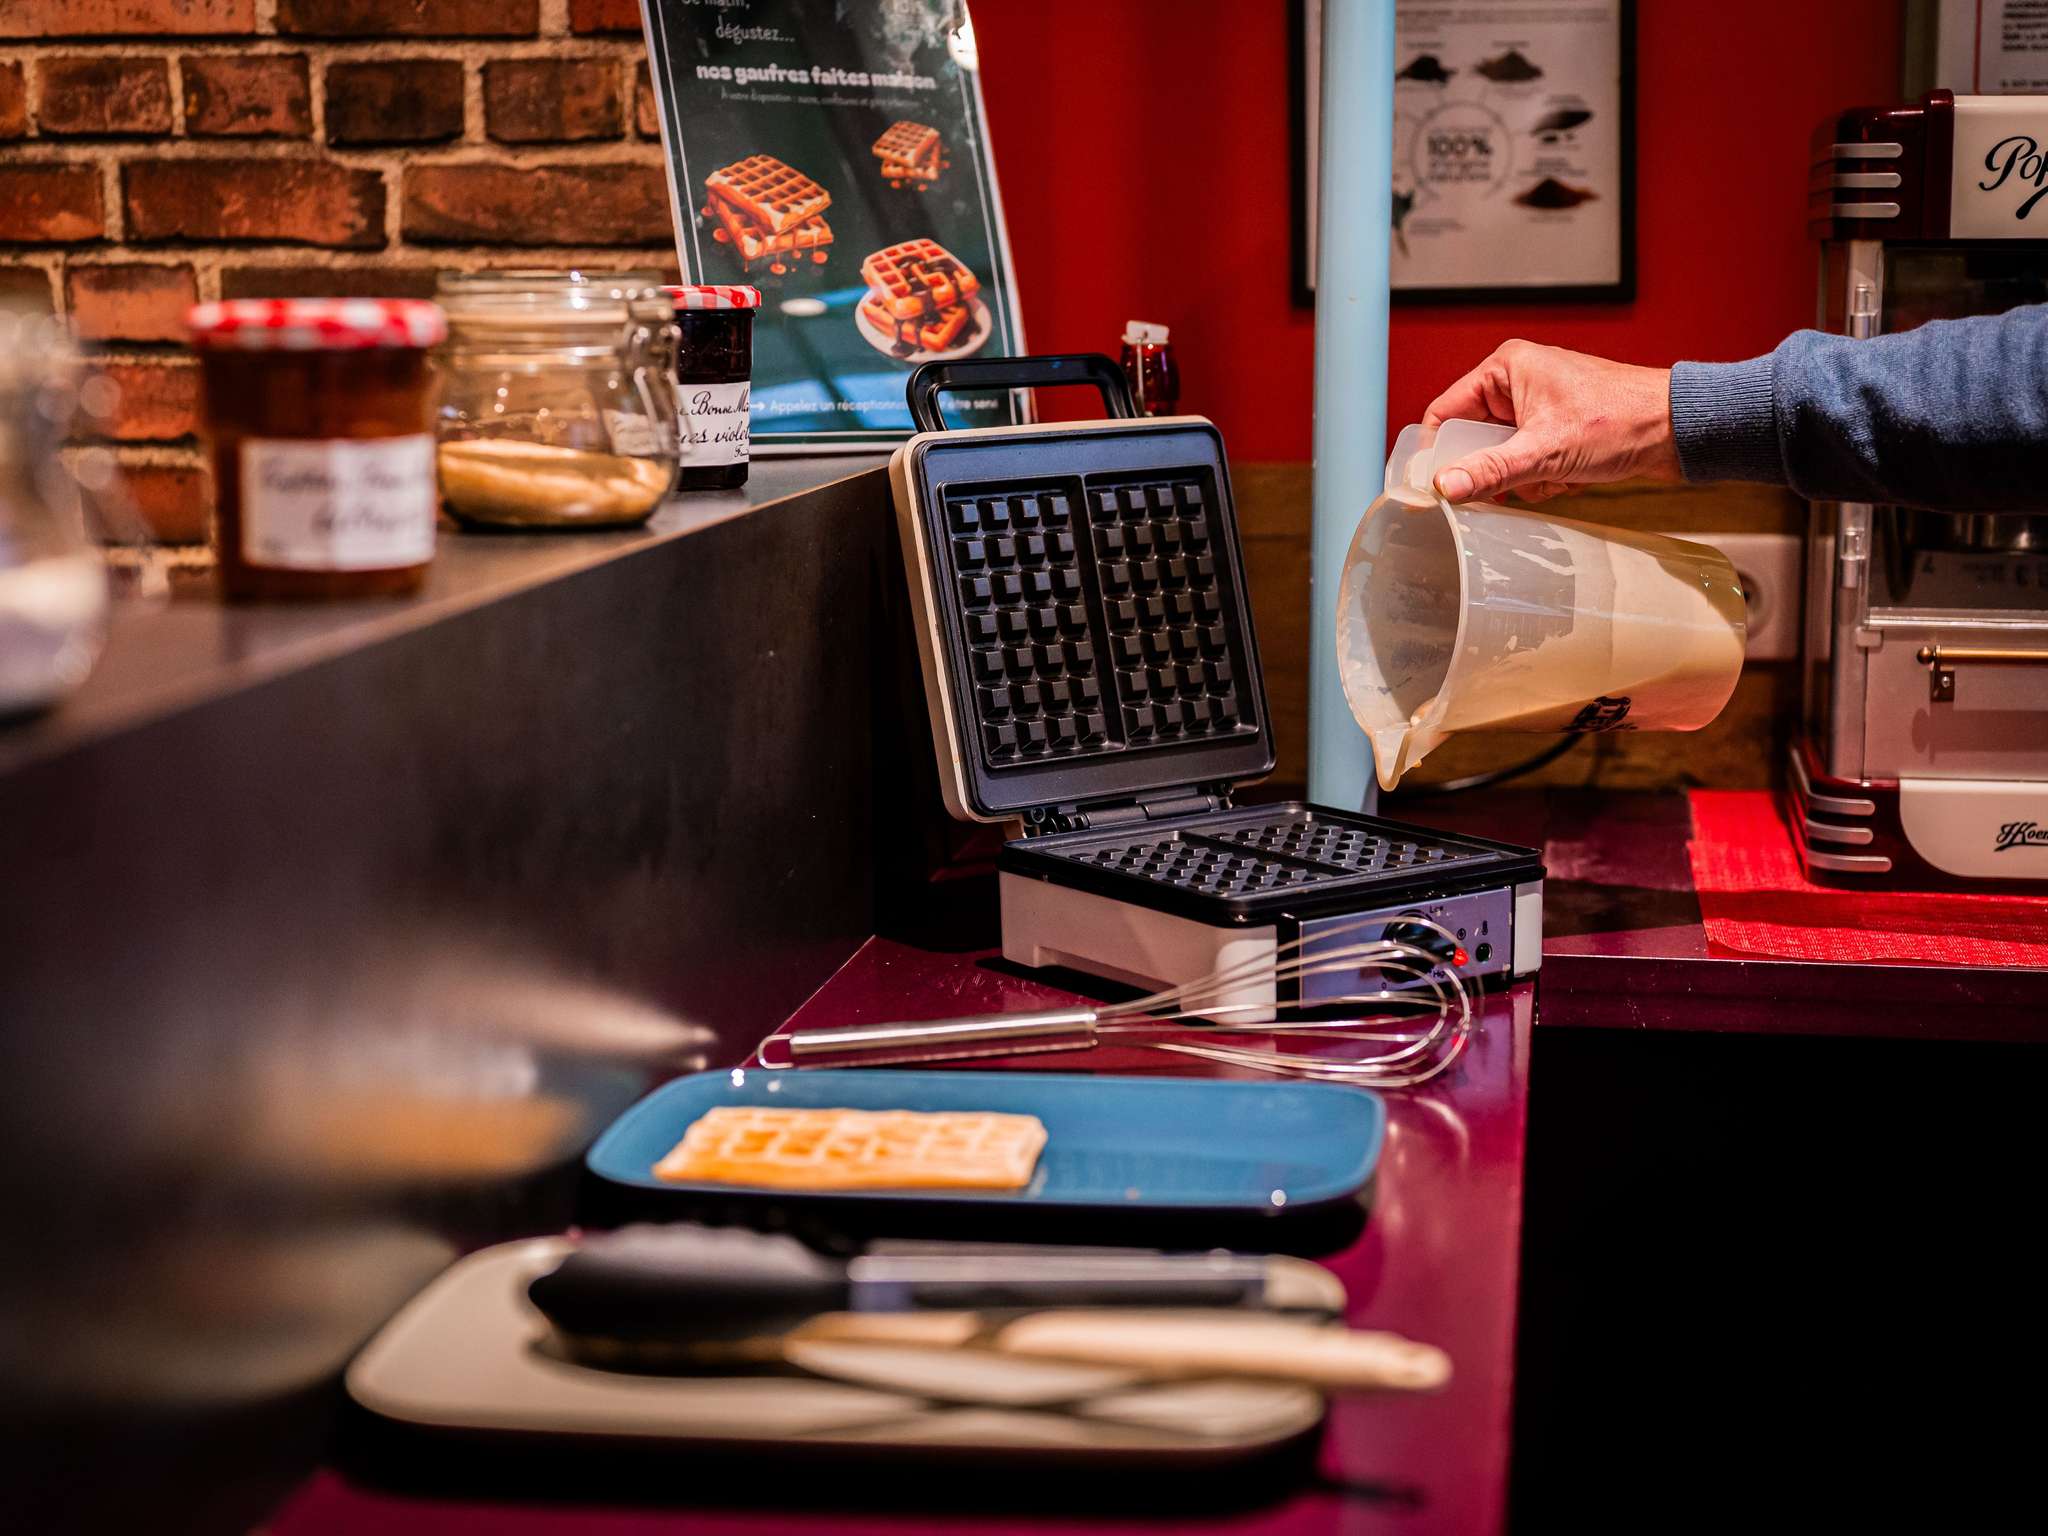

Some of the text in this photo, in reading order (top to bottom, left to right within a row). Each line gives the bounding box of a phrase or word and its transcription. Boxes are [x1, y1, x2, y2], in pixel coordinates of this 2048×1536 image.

[696, 63, 937, 90] nos gaufres faites maison
[691, 390, 733, 416] Bonne
[769, 399, 818, 415] Appelez
[820, 401, 836, 411] un
